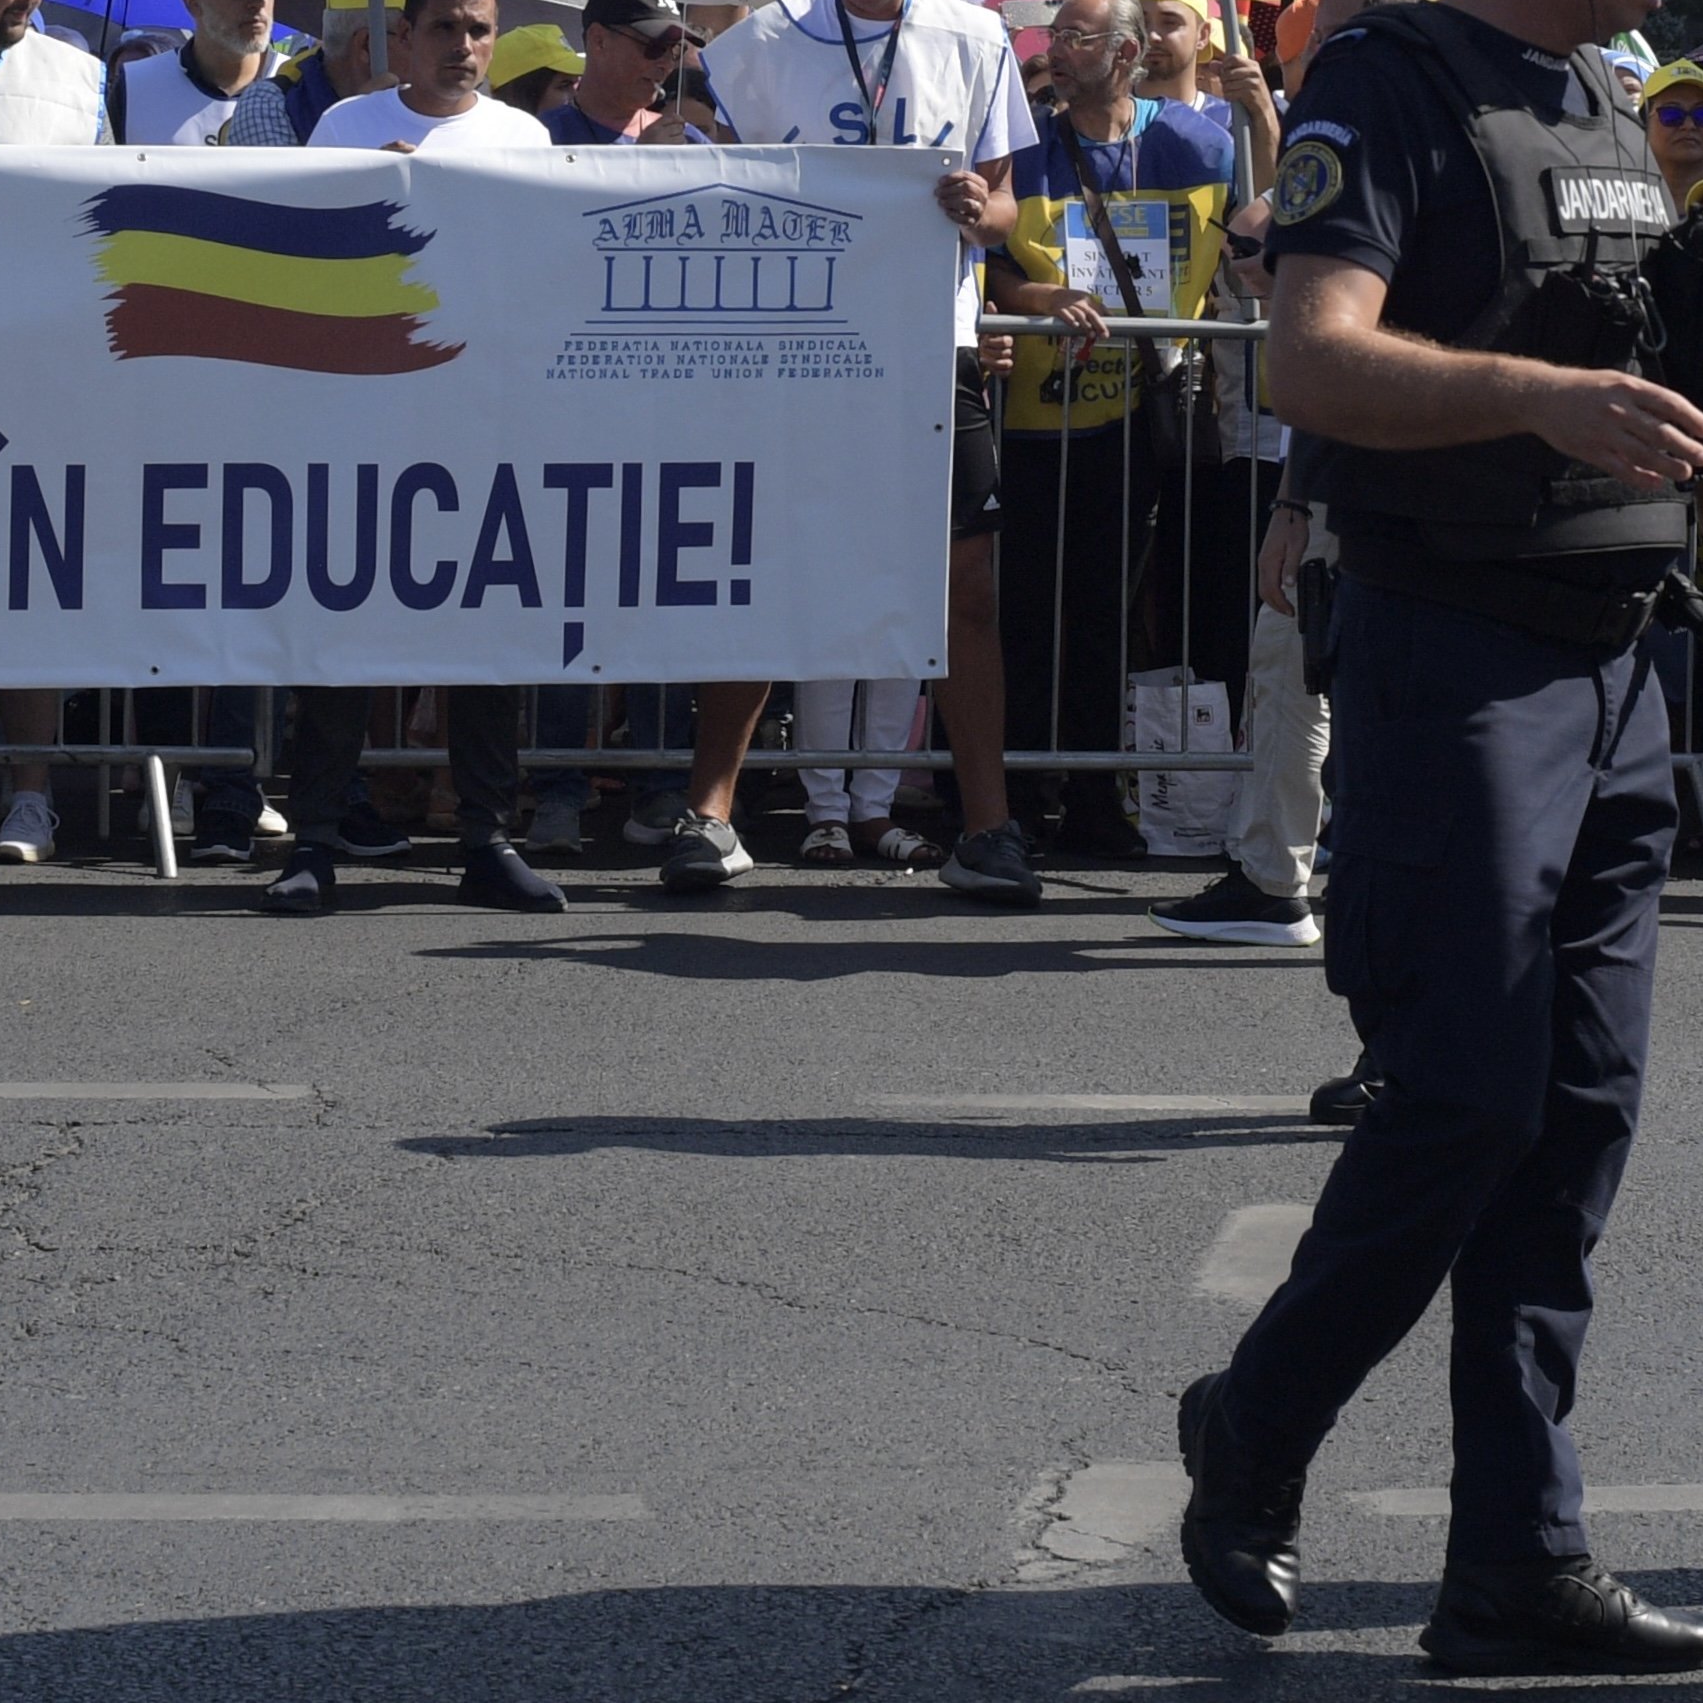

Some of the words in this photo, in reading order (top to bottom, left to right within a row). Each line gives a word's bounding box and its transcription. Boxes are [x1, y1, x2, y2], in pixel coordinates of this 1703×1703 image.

[1559, 178, 1670, 226] JANDARMERIA
[592, 203, 705, 247] ALMA
[719, 199, 853, 247] MATER
[1086, 284, 1146, 296] SECTR
[546, 368, 631, 380] NATIONAL
[640, 368, 694, 379] TRADE
[711, 368, 764, 379] UNION
[777, 367, 886, 379] FEDERATION
[555, 354, 666, 366] FEDERATION
[676, 354, 770, 366] NATIONALE
[140, 461, 755, 671] EDUCAȚIE!
